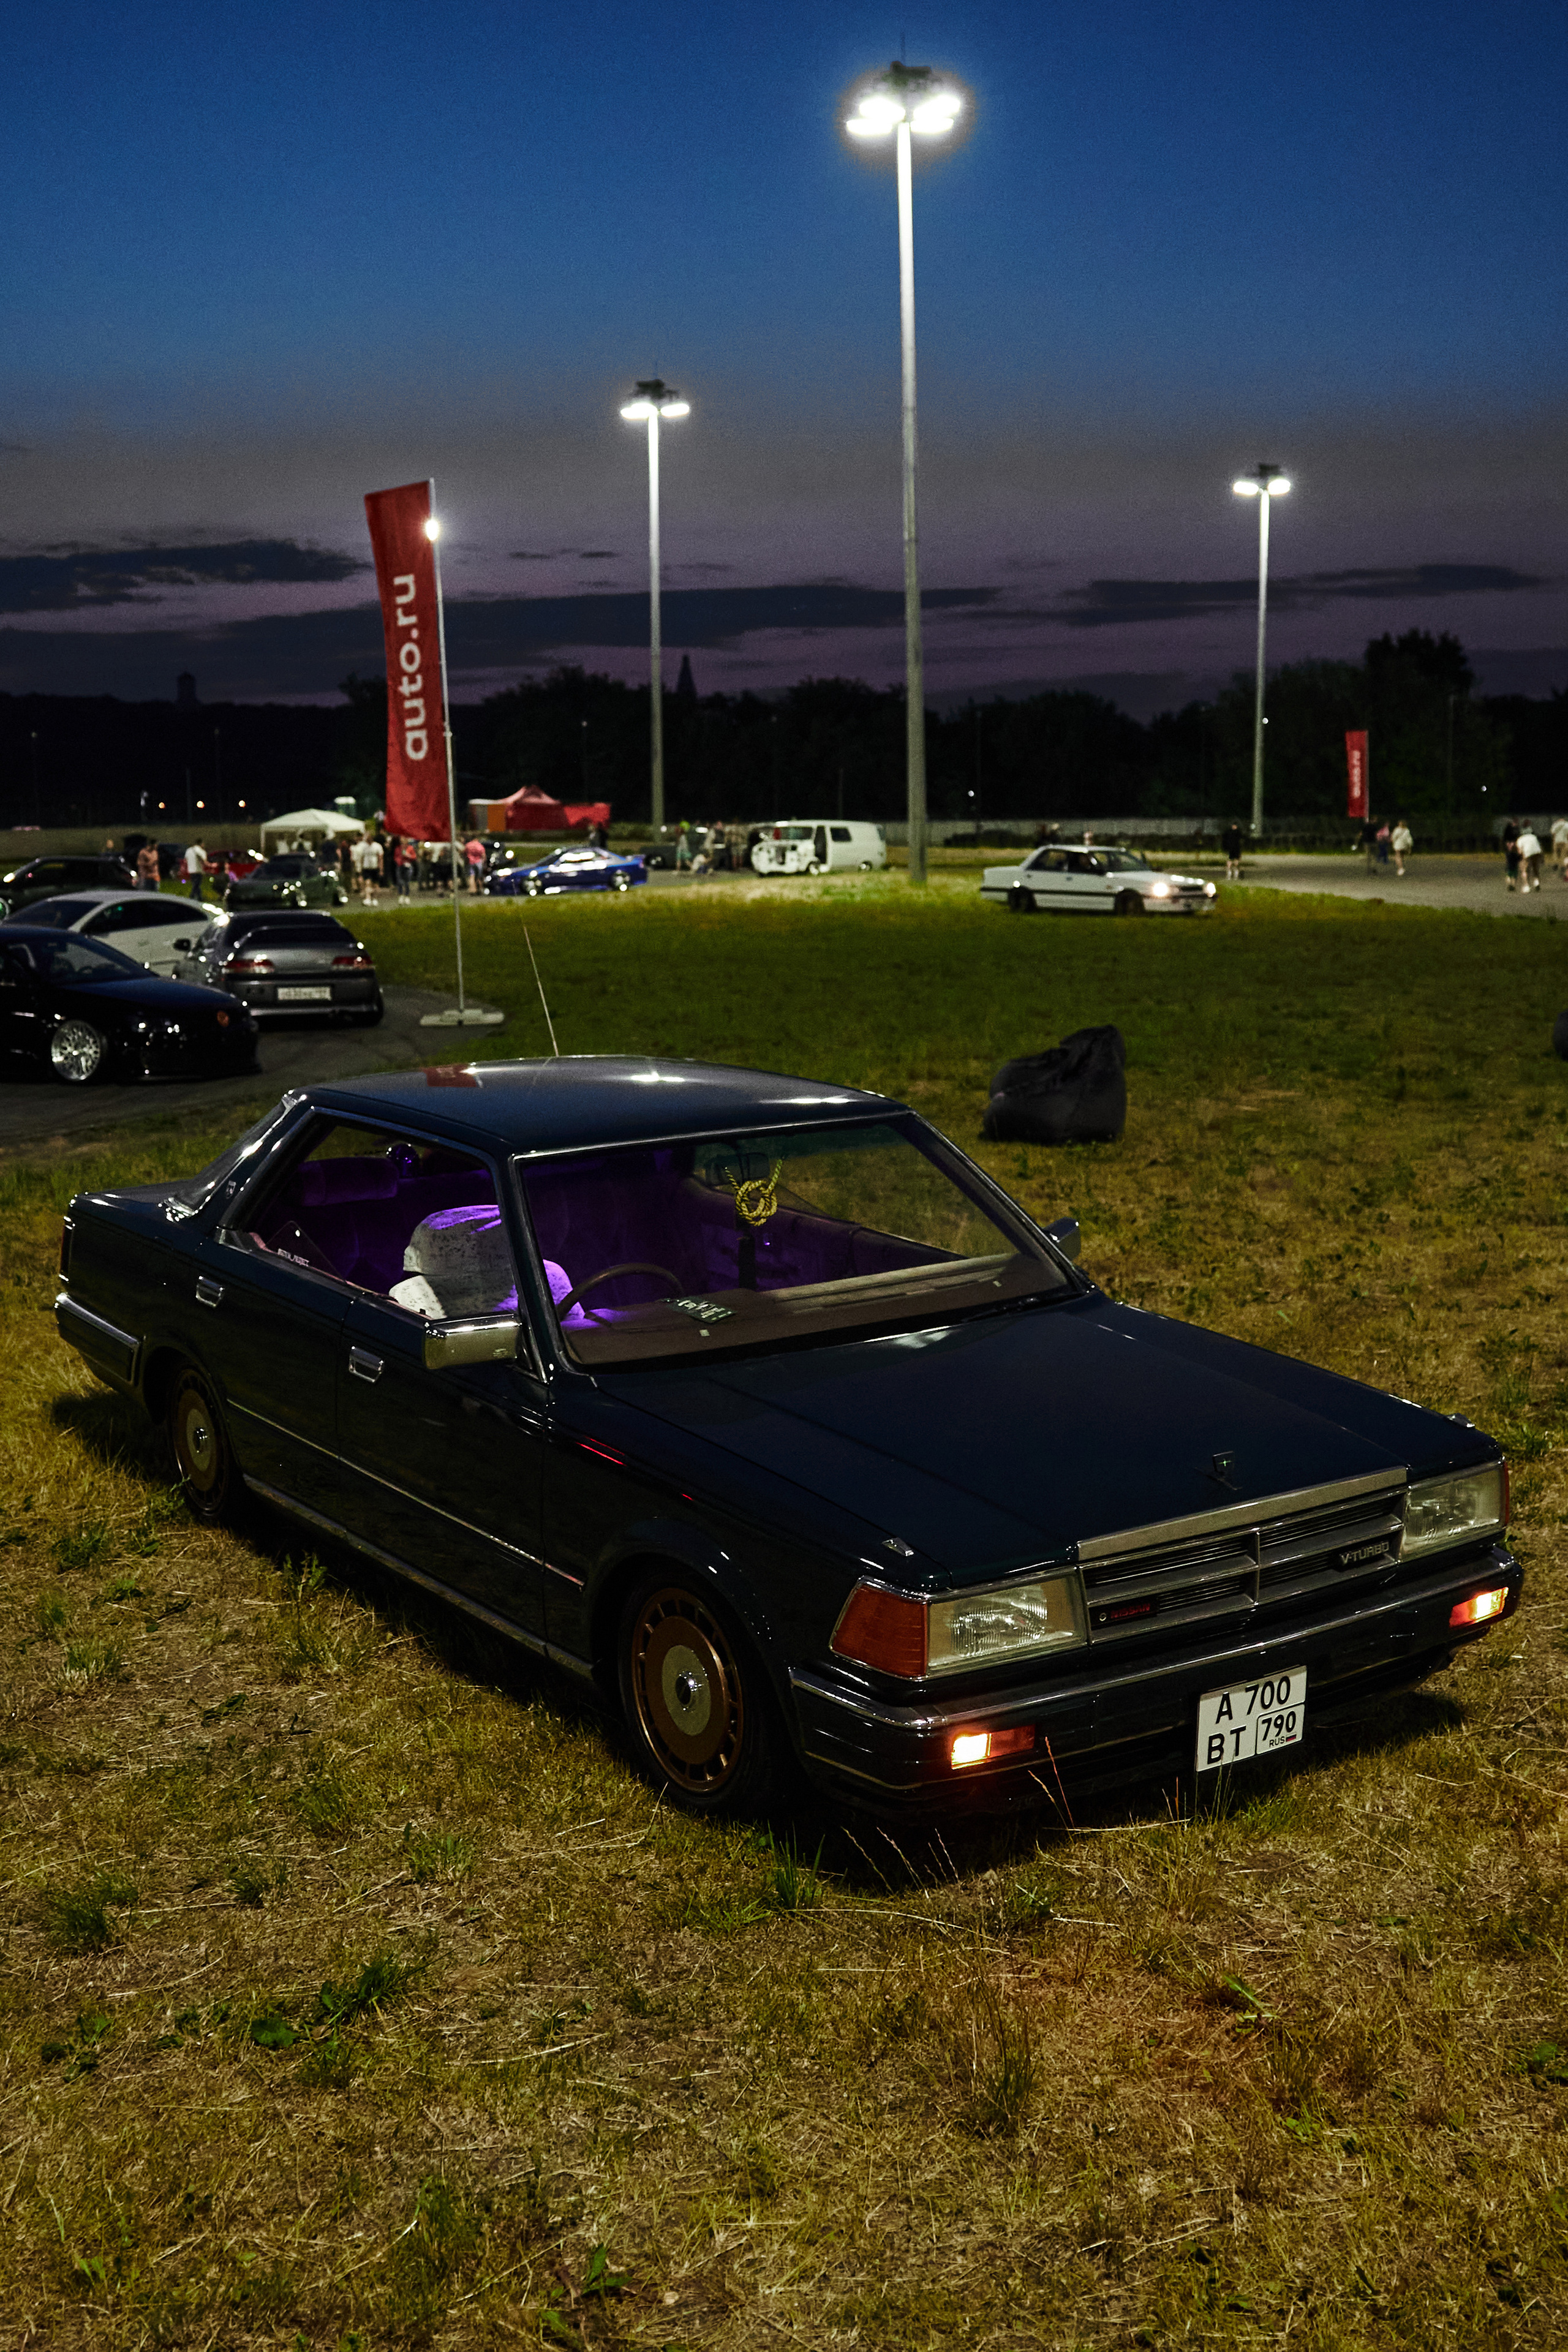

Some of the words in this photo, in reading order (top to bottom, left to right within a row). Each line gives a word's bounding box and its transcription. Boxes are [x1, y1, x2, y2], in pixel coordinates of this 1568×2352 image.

[393, 574, 428, 760] auto.ru
[1339, 1540, 1389, 1564] V-TURBO
[1110, 1603, 1151, 1618] NISSAN
[1216, 1692, 1233, 1724] A
[1245, 1676, 1291, 1716] 700
[1208, 1726, 1246, 1764] BT
[1262, 1711, 1295, 1741] 790
[1269, 1736, 1286, 1747] RUS
